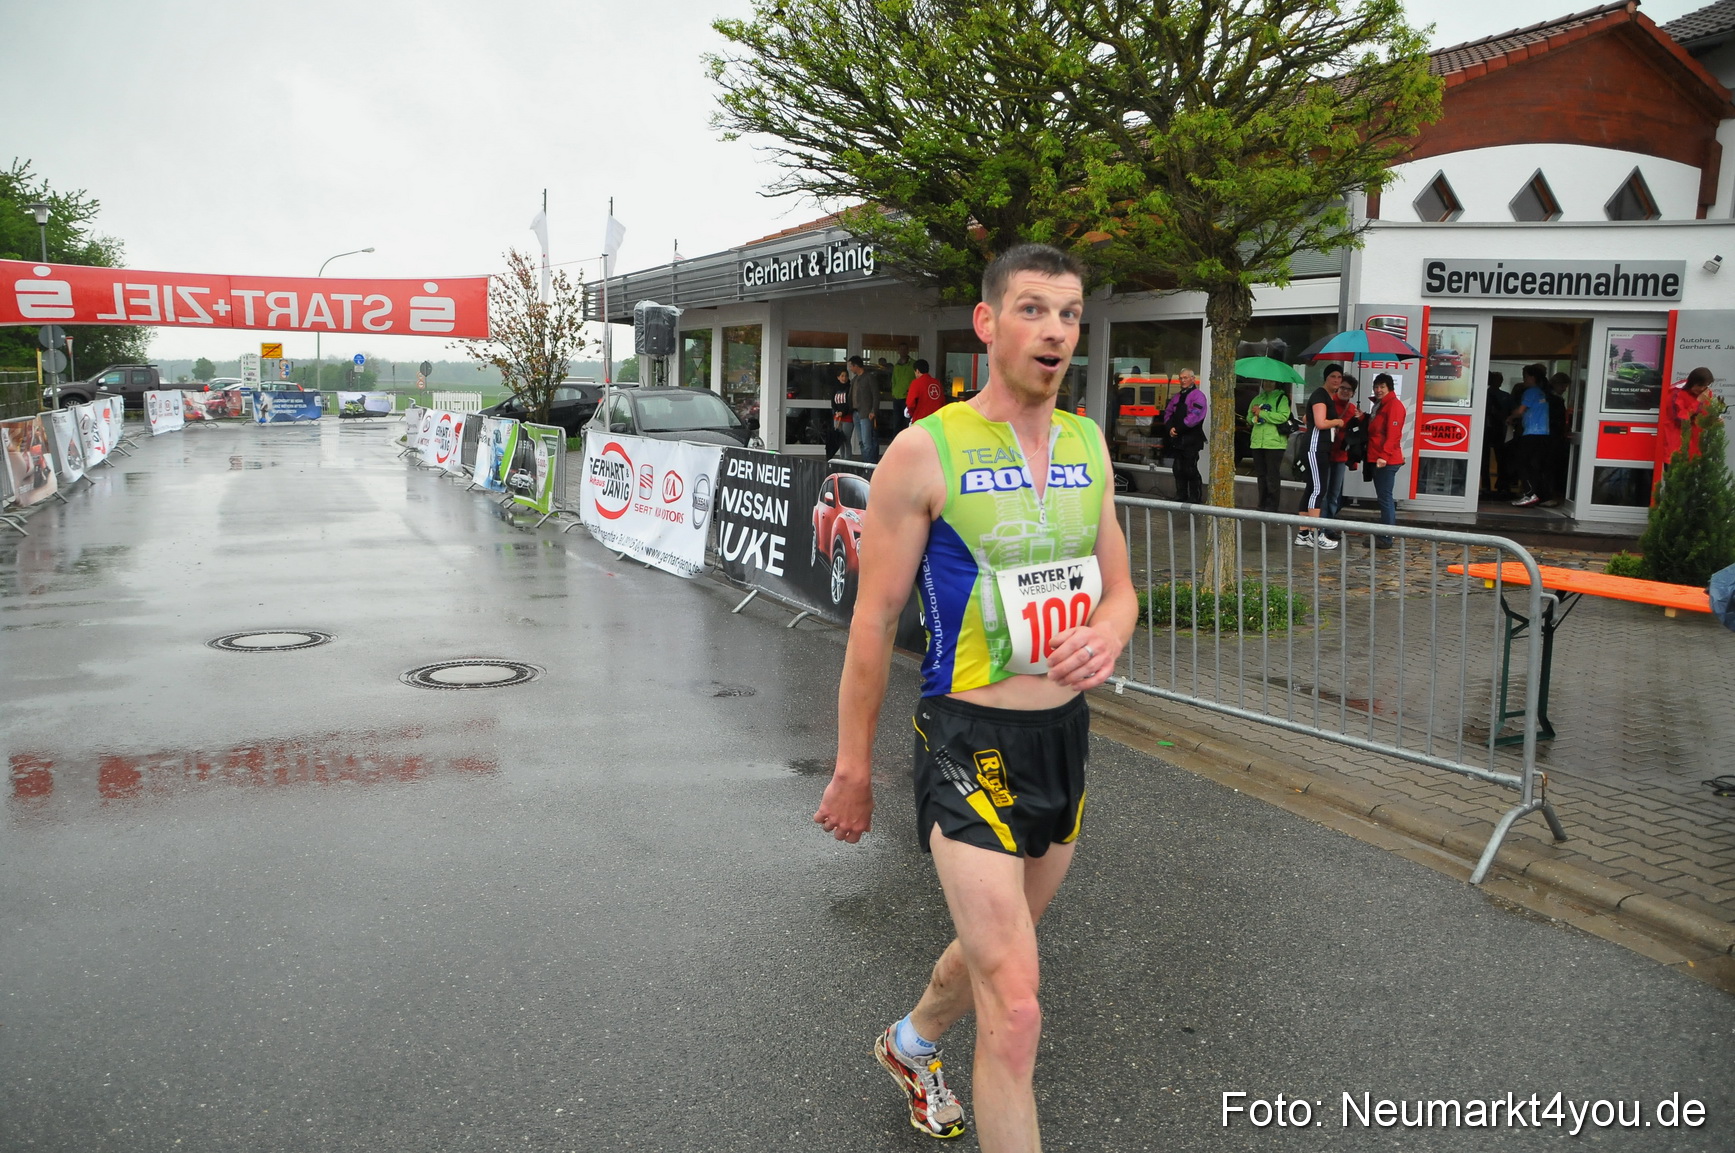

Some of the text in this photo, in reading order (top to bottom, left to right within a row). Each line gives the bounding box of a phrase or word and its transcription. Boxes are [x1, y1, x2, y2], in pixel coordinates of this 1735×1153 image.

[743, 240, 875, 287] Gerhart & Jänig
[1425, 261, 1679, 297] Serviceannahme
[1357, 361, 1413, 370] SEAT
[727, 458, 791, 488] DER NEUE
[634, 503, 653, 516] SEAT
[720, 485, 789, 527] NISSAN
[718, 520, 786, 577] JUKE
[1017, 569, 1065, 587] MEYER
[1019, 579, 1067, 597] WERBUNG
